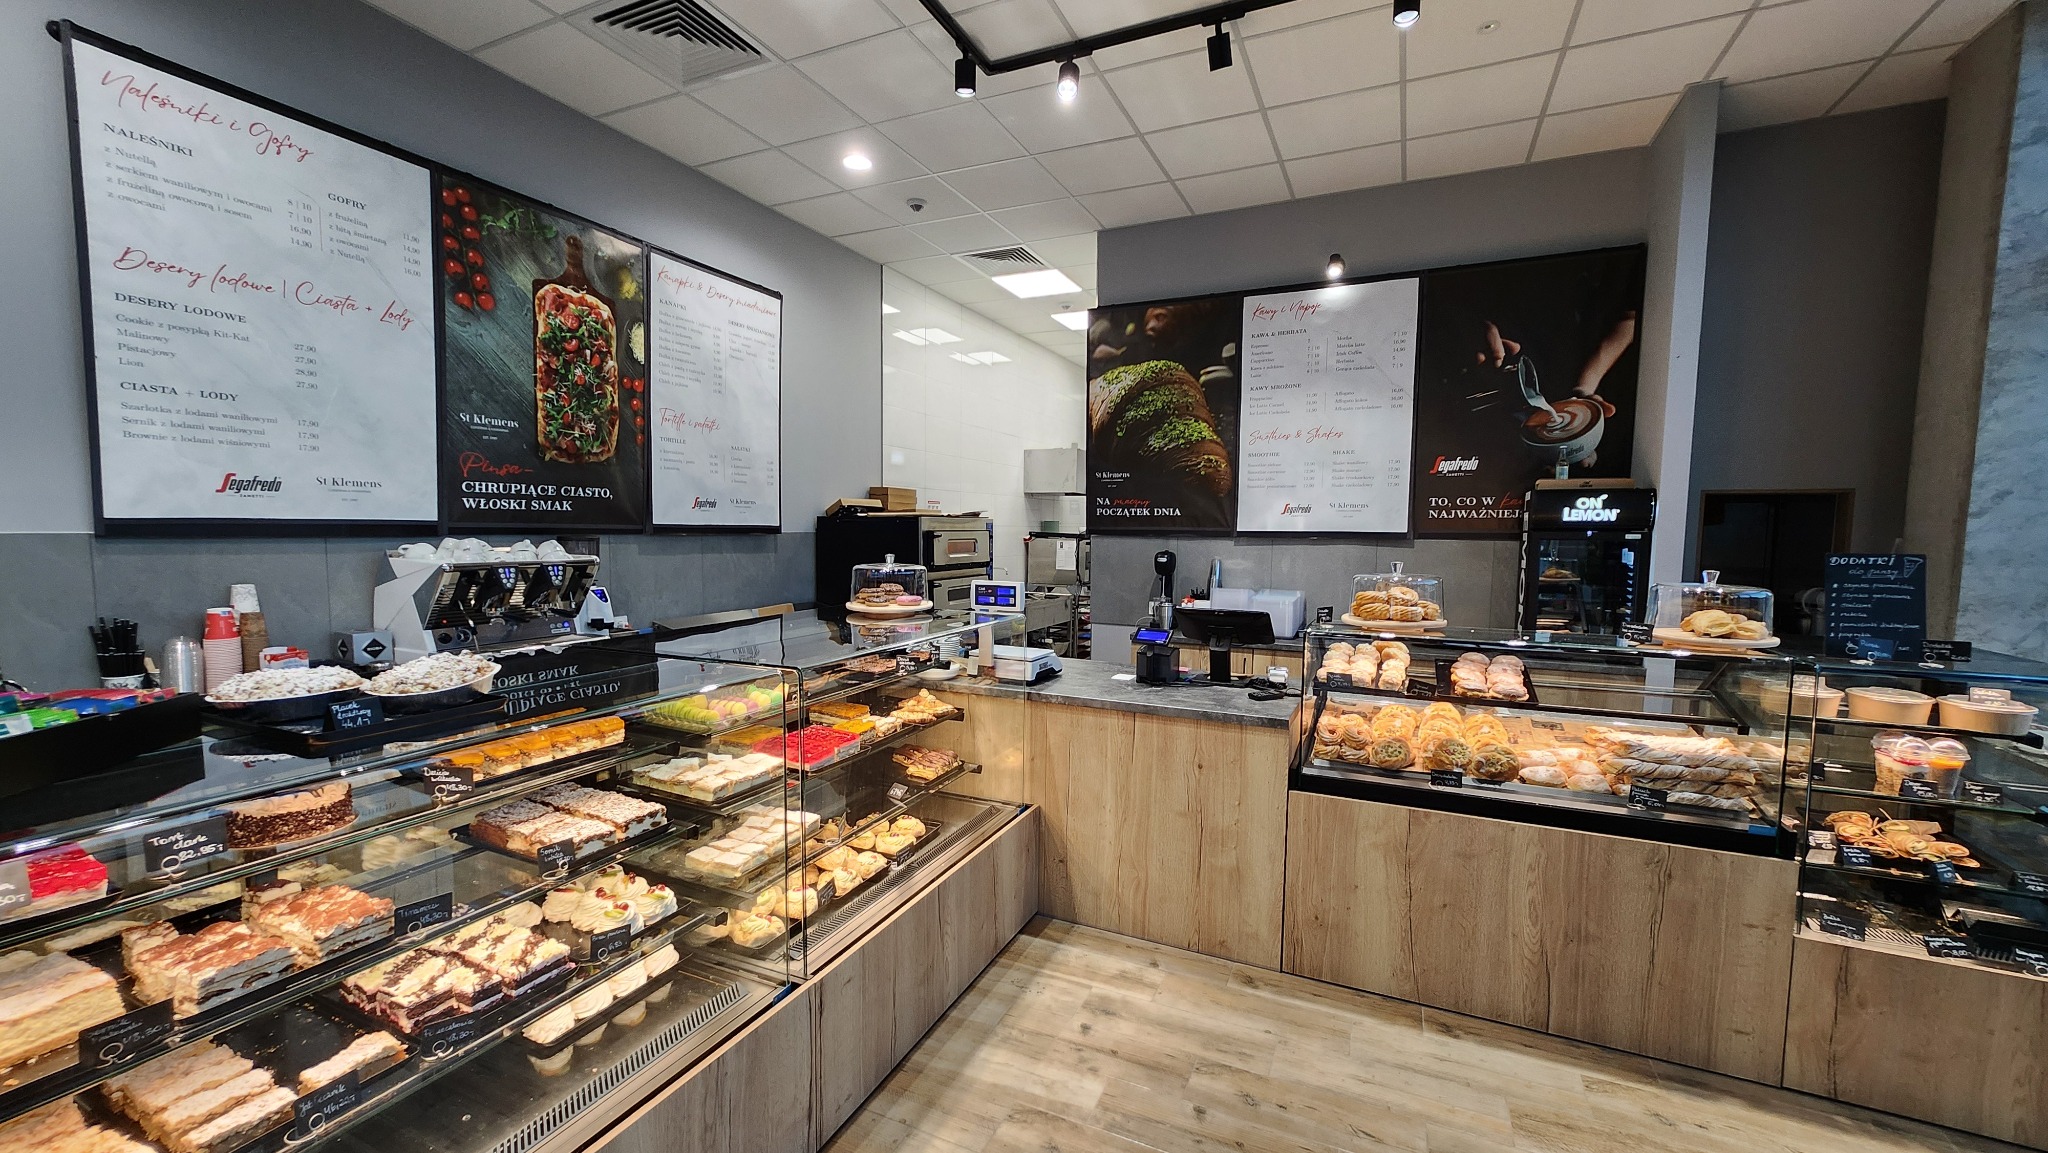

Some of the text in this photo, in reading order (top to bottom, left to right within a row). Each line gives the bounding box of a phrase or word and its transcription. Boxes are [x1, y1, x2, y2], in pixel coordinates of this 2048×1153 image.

[101, 70, 314, 162] Naleśniki i Gofry
[103, 122, 193, 157] NALEŚNIKI
[115, 147, 157, 168] Nutellą
[116, 163, 159, 181] serkiem
[162, 177, 224, 200] waniliowym
[233, 198, 273, 213] owocami
[118, 194, 166, 212] owocami
[302, 203, 312, 211] 10
[328, 193, 367, 210] GOFRY
[224, 208, 252, 220] sosem
[303, 215, 313, 224] 10
[113, 247, 206, 287] Desery
[296, 281, 360, 316] Ciasta
[380, 300, 415, 330] Lody
[114, 292, 248, 324] DESERY LODOWE
[1252, 302, 1278, 321] Kawy
[115, 313, 155, 329] Cookie
[213, 329, 250, 343] Kit-Kat
[116, 328, 170, 345] Malinowy
[117, 343, 177, 359] Pistacjowy
[118, 357, 145, 368] Lion
[119, 381, 180, 396] CIASTA
[200, 390, 239, 402] LODY
[1270, 383, 1302, 391] MROŻONE
[120, 401, 173, 416] Szarlotka
[185, 406, 219, 420] lodami
[121, 416, 157, 428] Sernik
[170, 419, 205, 432] lodami
[460, 412, 520, 428] St Klemens
[122, 430, 168, 443] Brownie
[180, 434, 215, 445] lodami
[1306, 425, 1344, 444] Shakes
[459, 452, 522, 478] Pinsa
[1429, 455, 1479, 474] Segafredo
[215, 473, 283, 493] Segafredo
[316, 476, 383, 488] St Klemens
[1102, 471, 1131, 479] Klemens
[461, 480, 614, 500] CHRUPIĄCE CIASTO,
[462, 497, 573, 511] WŁOSKI SMAK
[692, 496, 718, 510] Segafredo
[1096, 497, 1111, 506] NA
[1281, 503, 1312, 515] Segafredo
[1429, 497, 1452, 508] TO,
[1456, 496, 1477, 506] CO
[1481, 496, 1496, 506] W
[1575, 495, 1604, 510] ON
[1096, 507, 1182, 518] POCZĄTEK DNIA
[1562, 506, 1619, 522] LEMON
[148, 832, 185, 847] Tort
